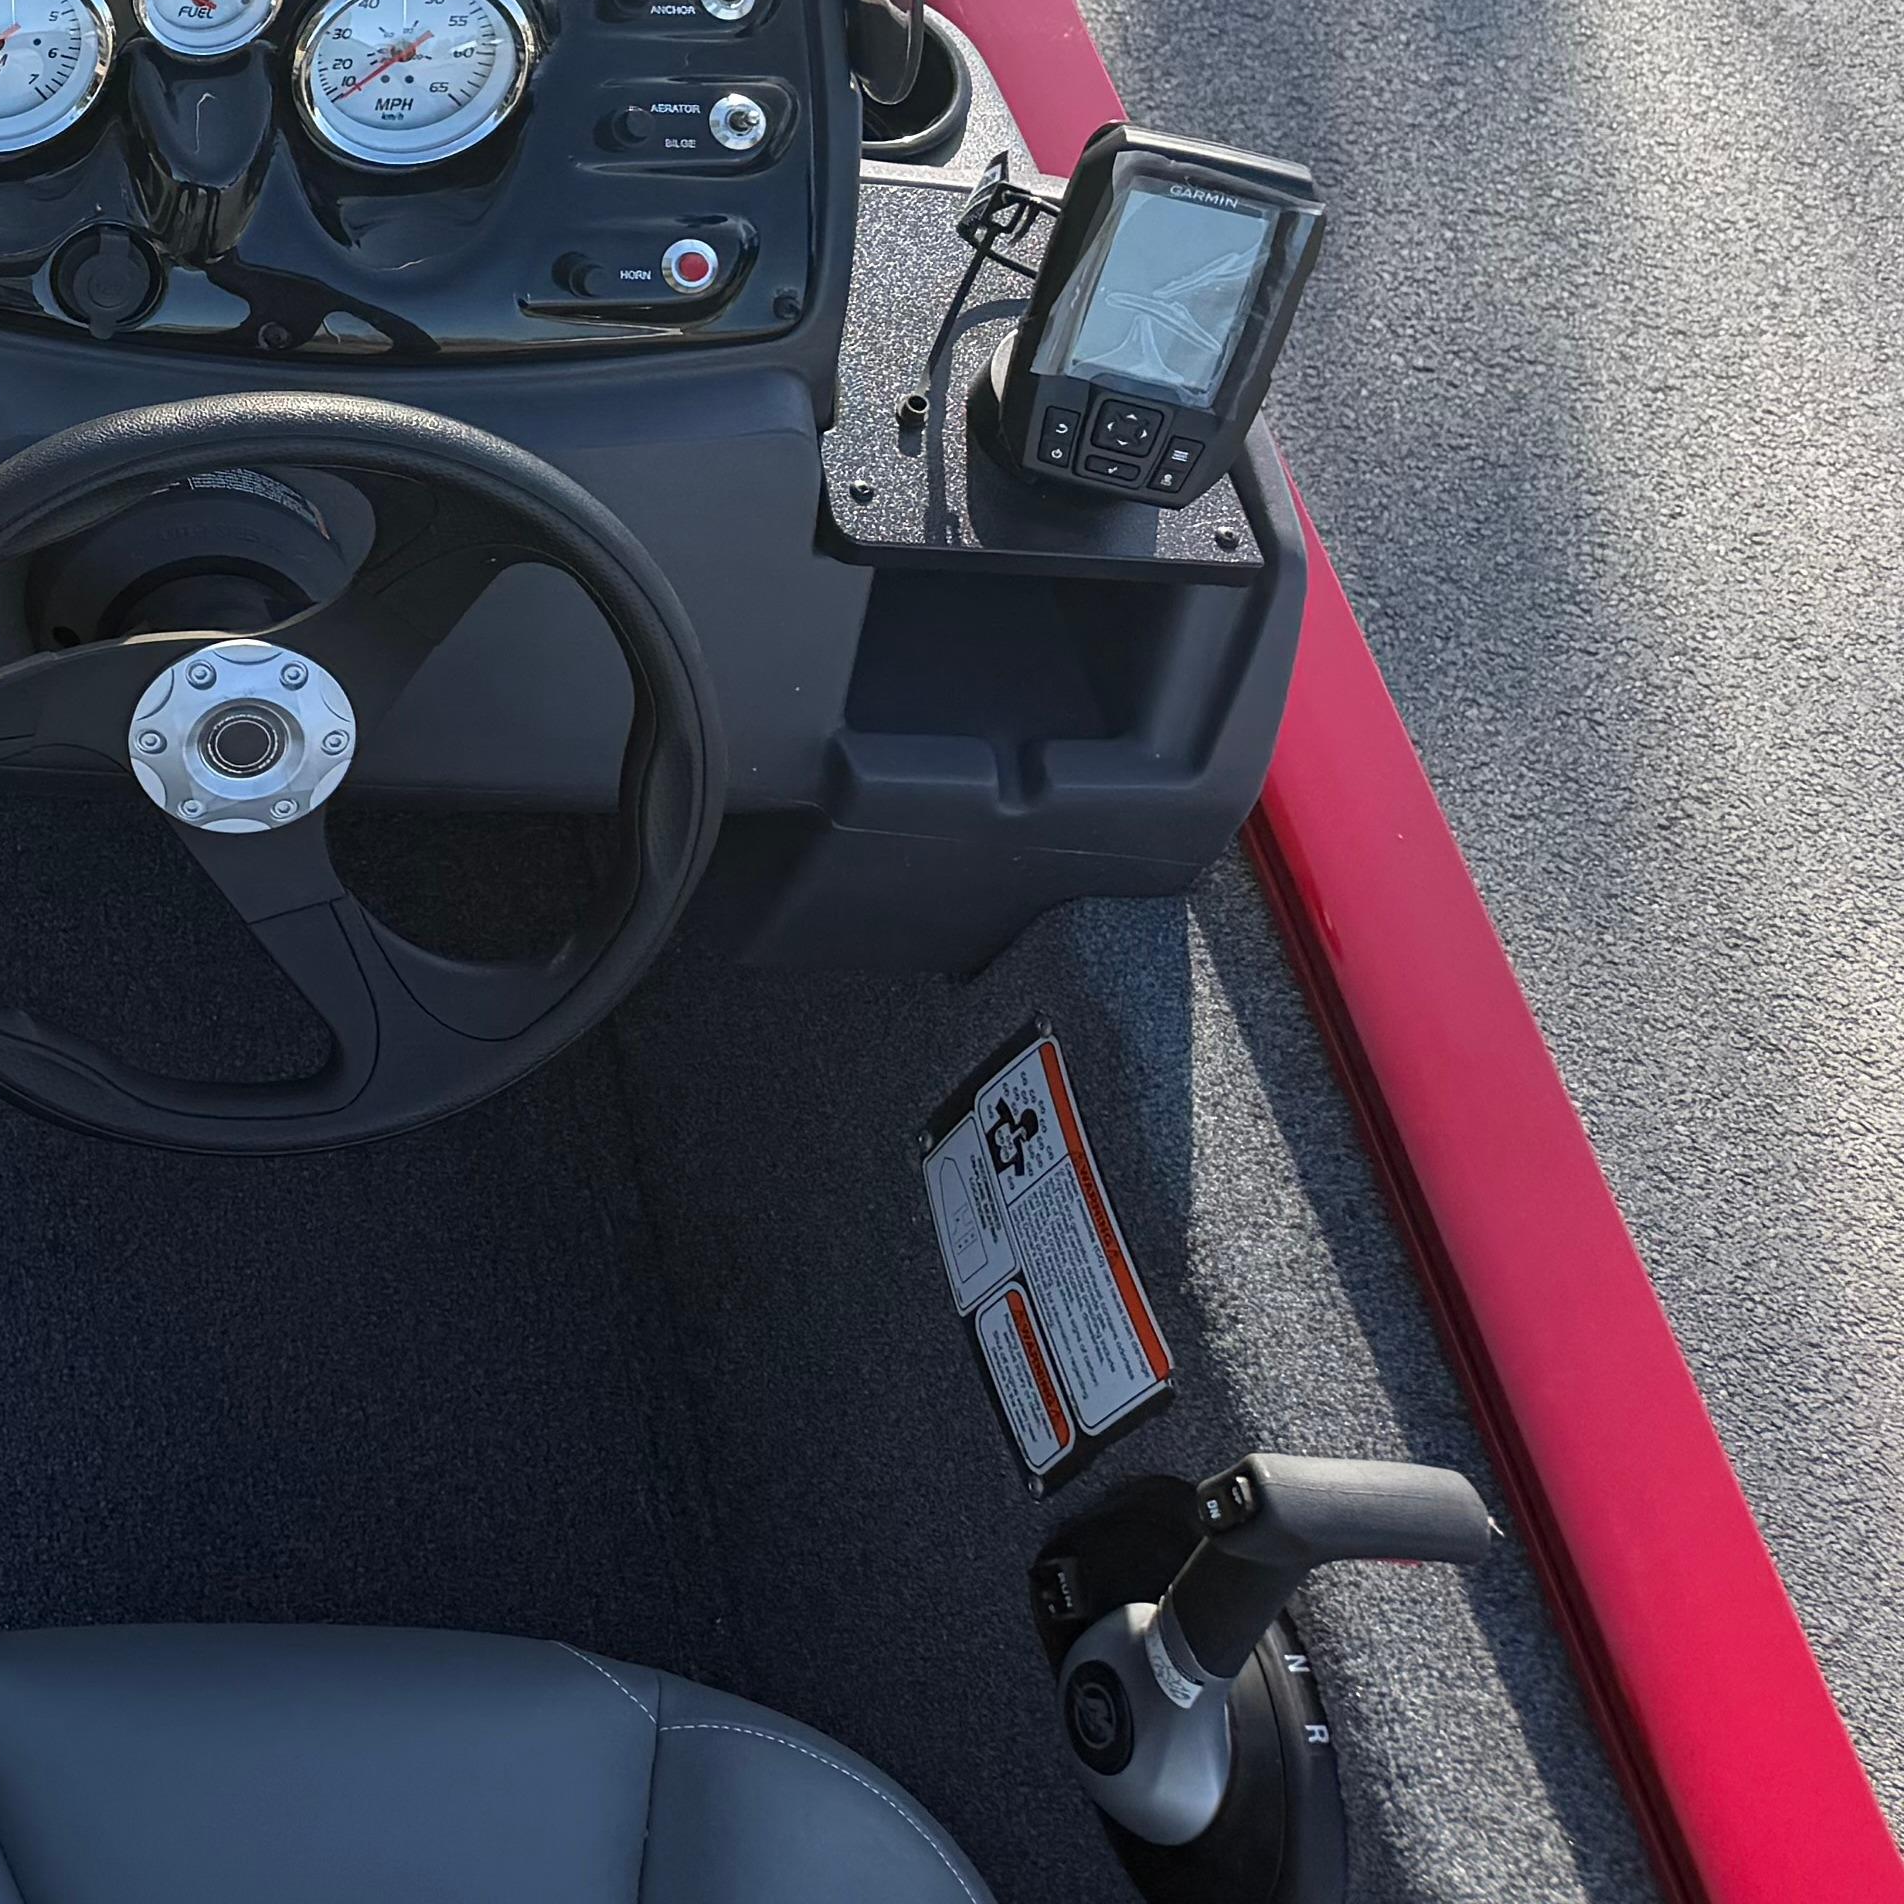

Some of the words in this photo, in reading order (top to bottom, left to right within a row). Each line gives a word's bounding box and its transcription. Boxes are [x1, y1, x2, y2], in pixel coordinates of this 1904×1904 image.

[178, 6, 214, 19] FUEL
[650, 5, 696, 15] ANCHOR
[49, 11, 59, 22] 5
[448, 15, 469, 27] 55
[332, 28, 353, 40] 30
[48, 48, 58, 59] 6
[453, 47, 475, 59] 60
[332, 58, 353, 70] 20
[28, 74, 39, 85] 7
[341, 75, 357, 87] 10
[429, 81, 449, 93] 65
[374, 98, 414, 111] MPH
[650, 104, 701, 114] AERATOR
[665, 138, 696, 149] BILGE
[1169, 185, 1239, 210] GARMIN
[619, 270, 651, 281] HORN
[1080, 1165, 1112, 1246] WARNING
[1023, 1324, 1054, 1405] WARNING
[1206, 1499, 1221, 1519] DN
[1284, 1654, 1311, 1672] N
[1304, 1724, 1329, 1743] R
